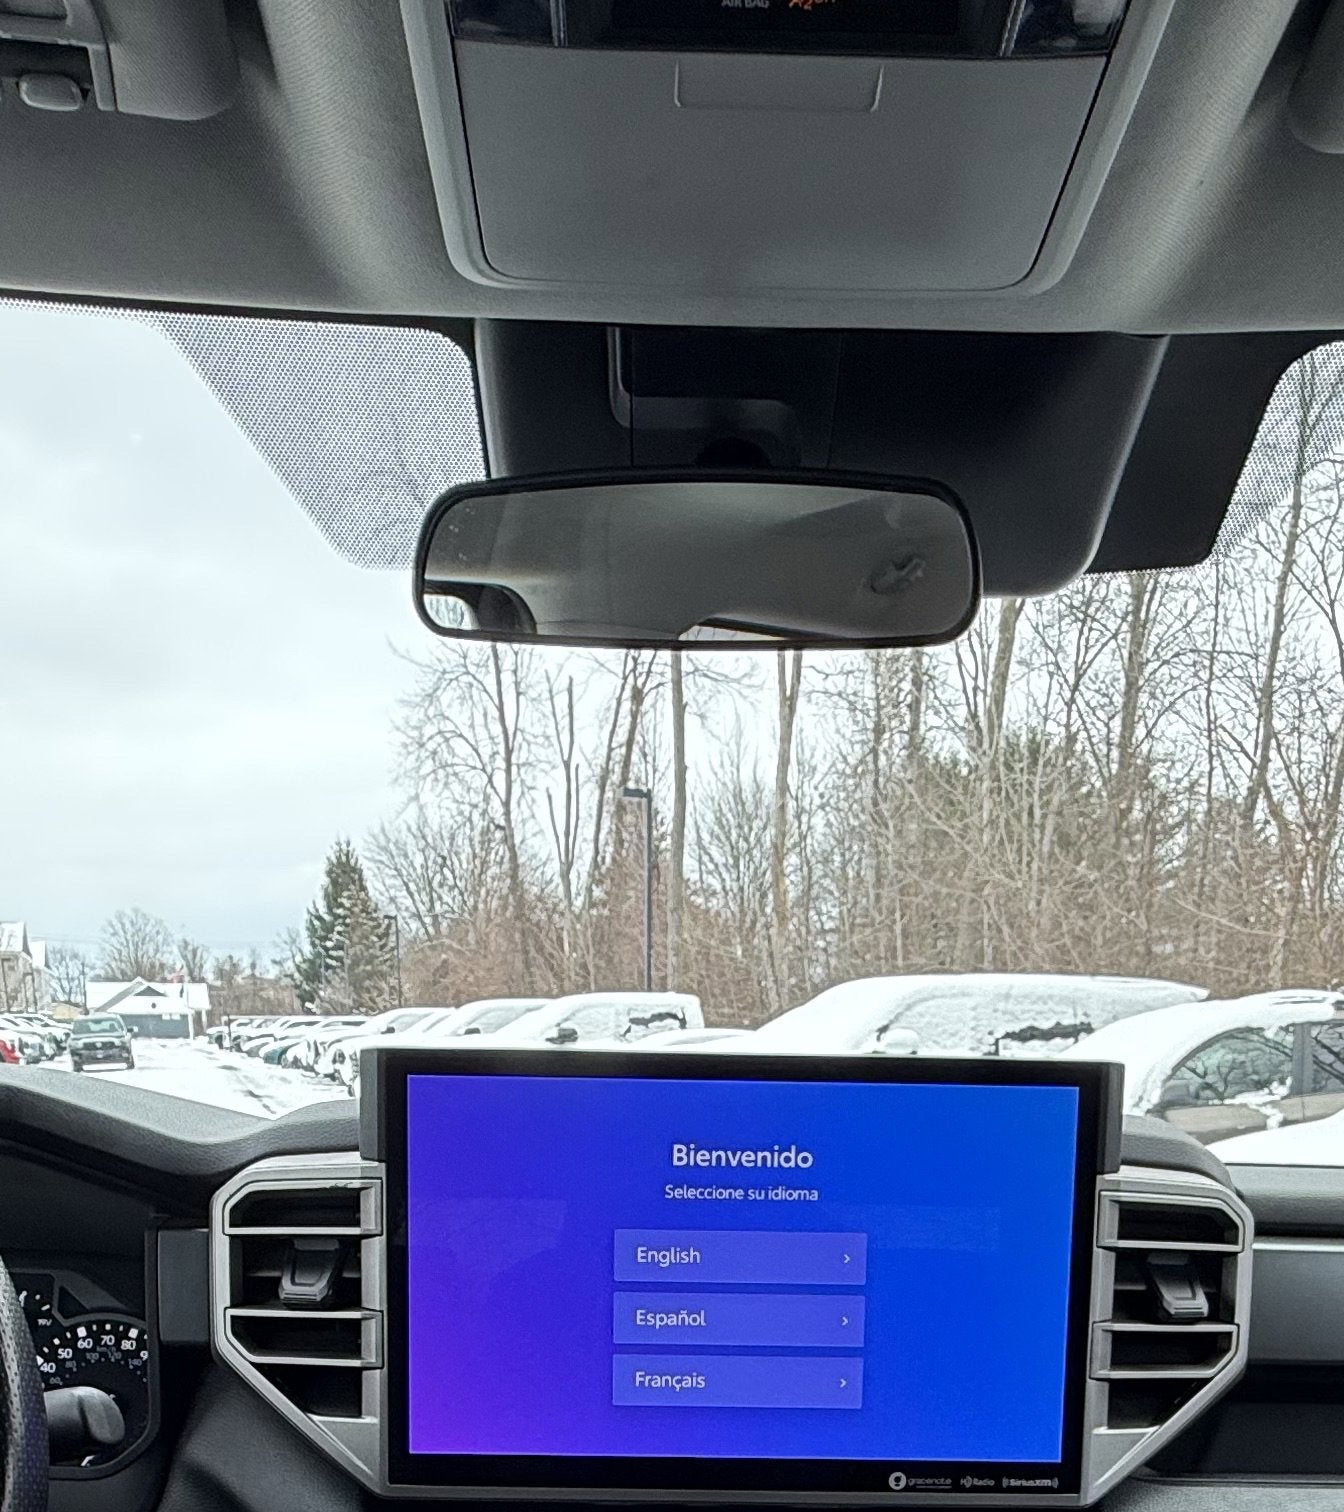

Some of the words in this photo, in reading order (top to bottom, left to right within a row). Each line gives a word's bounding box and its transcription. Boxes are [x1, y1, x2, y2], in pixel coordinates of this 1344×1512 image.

[672, 1144, 814, 1168] Bienvenido
[664, 1184, 745, 1200] Seleccione
[747, 1188, 766, 1201] su
[767, 1186, 819, 1201] idioma
[637, 1247, 701, 1267] English
[636, 1309, 706, 1329] Español
[77, 1338, 92, 1348] 60
[100, 1335, 115, 1345] 70
[120, 1339, 136, 1350] 80
[57, 1348, 72, 1358] 50
[39, 1362, 56, 1372] 40
[635, 1371, 706, 1391] Français
